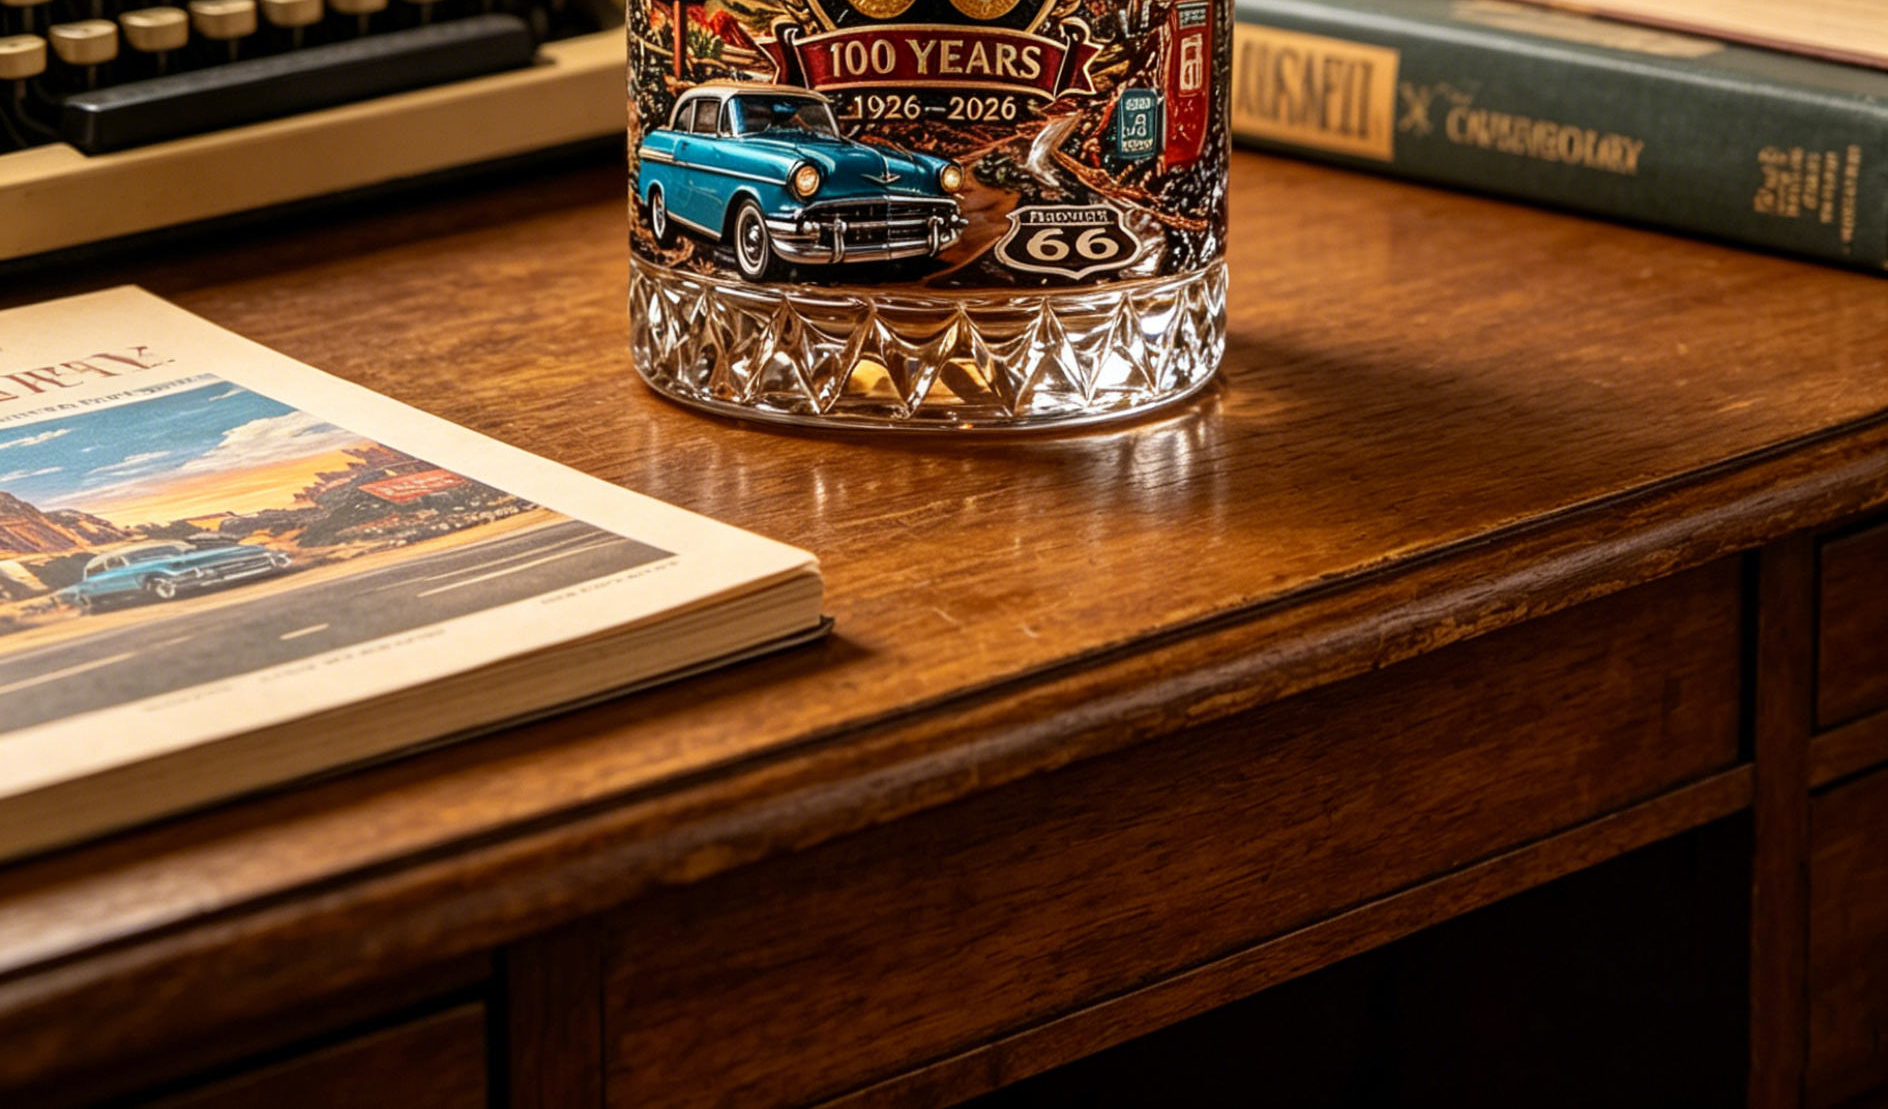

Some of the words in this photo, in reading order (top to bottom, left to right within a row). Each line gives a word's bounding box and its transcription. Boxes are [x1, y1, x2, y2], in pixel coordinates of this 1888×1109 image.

[830, 40, 896, 78] 100
[905, 39, 1042, 79] YEARS
[1026, 227, 1119, 261] 66
